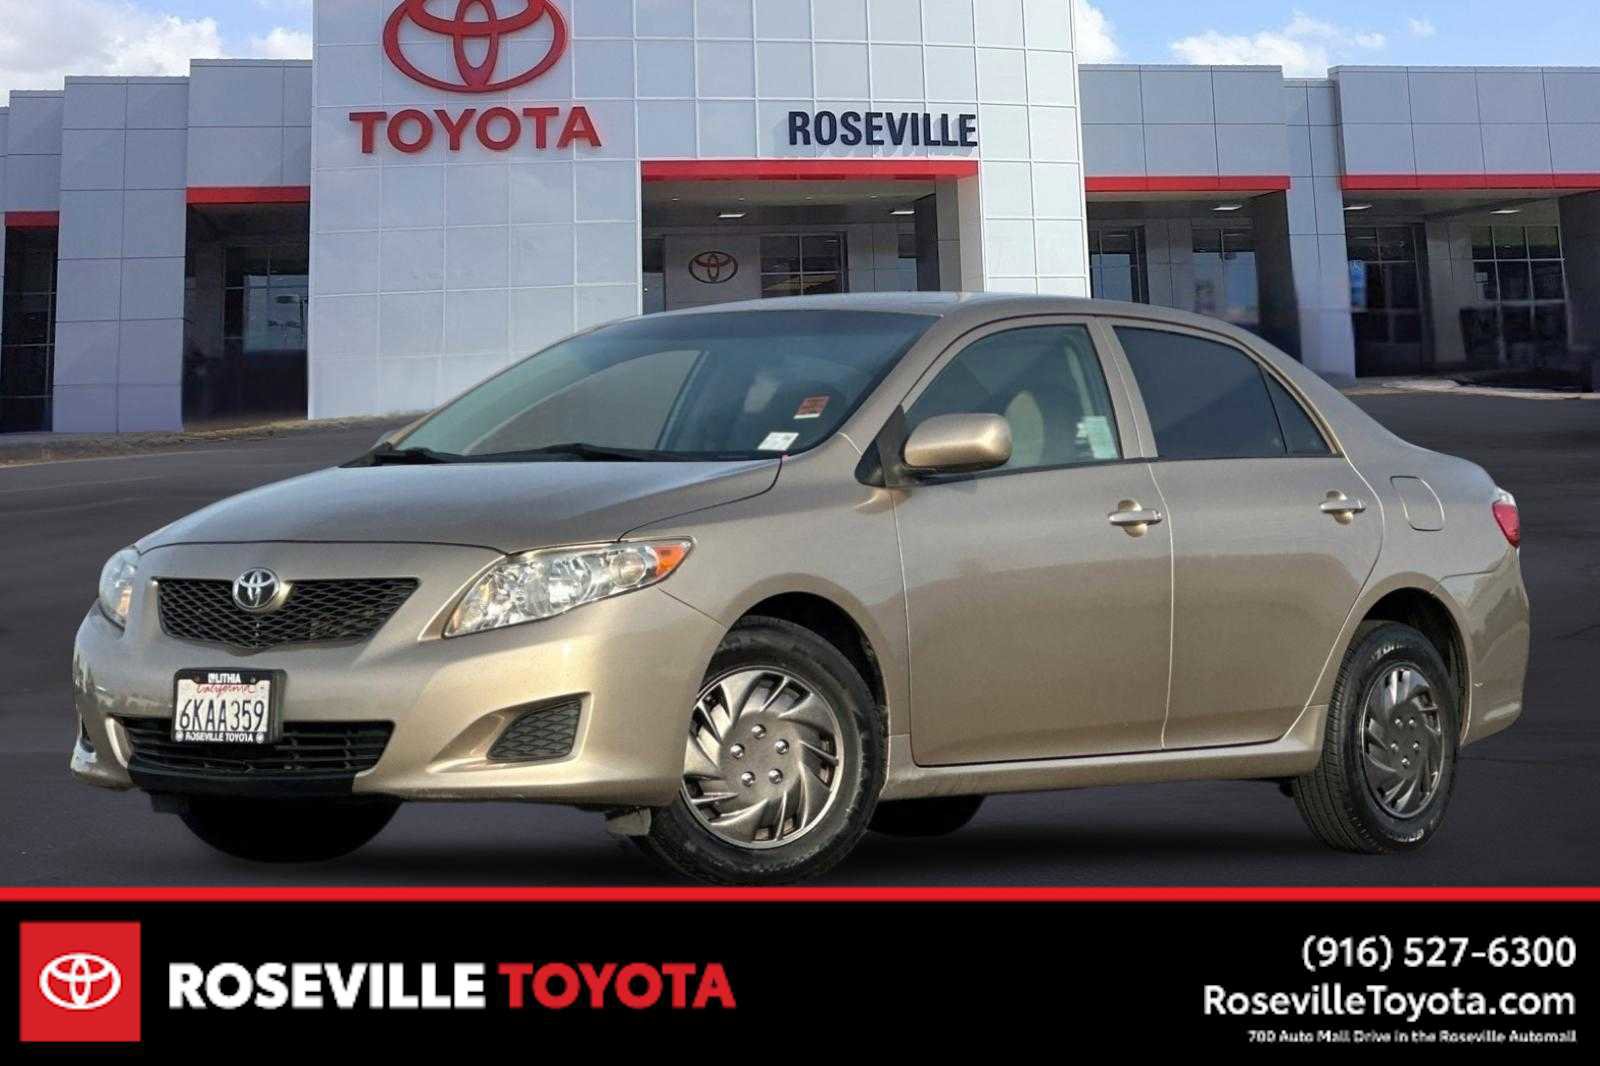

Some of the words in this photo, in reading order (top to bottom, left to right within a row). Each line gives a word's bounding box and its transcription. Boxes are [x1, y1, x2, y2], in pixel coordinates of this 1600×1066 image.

[349, 106, 602, 154] TOYOTA
[788, 111, 978, 147] ROSEVILLE
[216, 673, 241, 683] LITHIA
[196, 683, 256, 698] California
[180, 699, 264, 732] 6KAA359
[185, 732, 224, 742] ROSEVILLE
[225, 732, 253, 743] TOYOTA
